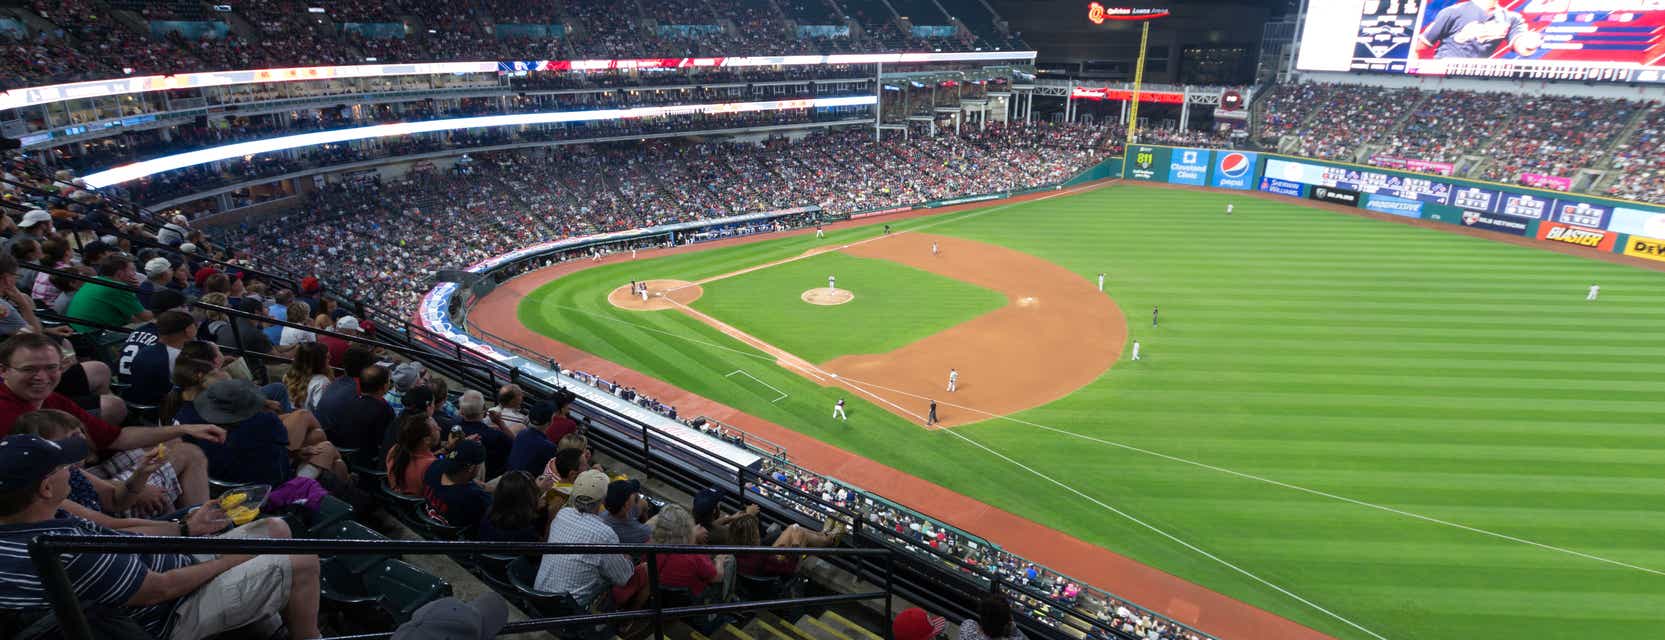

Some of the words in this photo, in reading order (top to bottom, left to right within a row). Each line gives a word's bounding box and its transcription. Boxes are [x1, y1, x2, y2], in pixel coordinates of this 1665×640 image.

[1137, 153, 1153, 164] 811
[1170, 163, 1207, 173] Cleveland
[1177, 171, 1198, 179] Clinic
[1220, 179, 1244, 187] pepsi
[1327, 192, 1354, 201] RAM
[119, 344, 139, 375] 2
